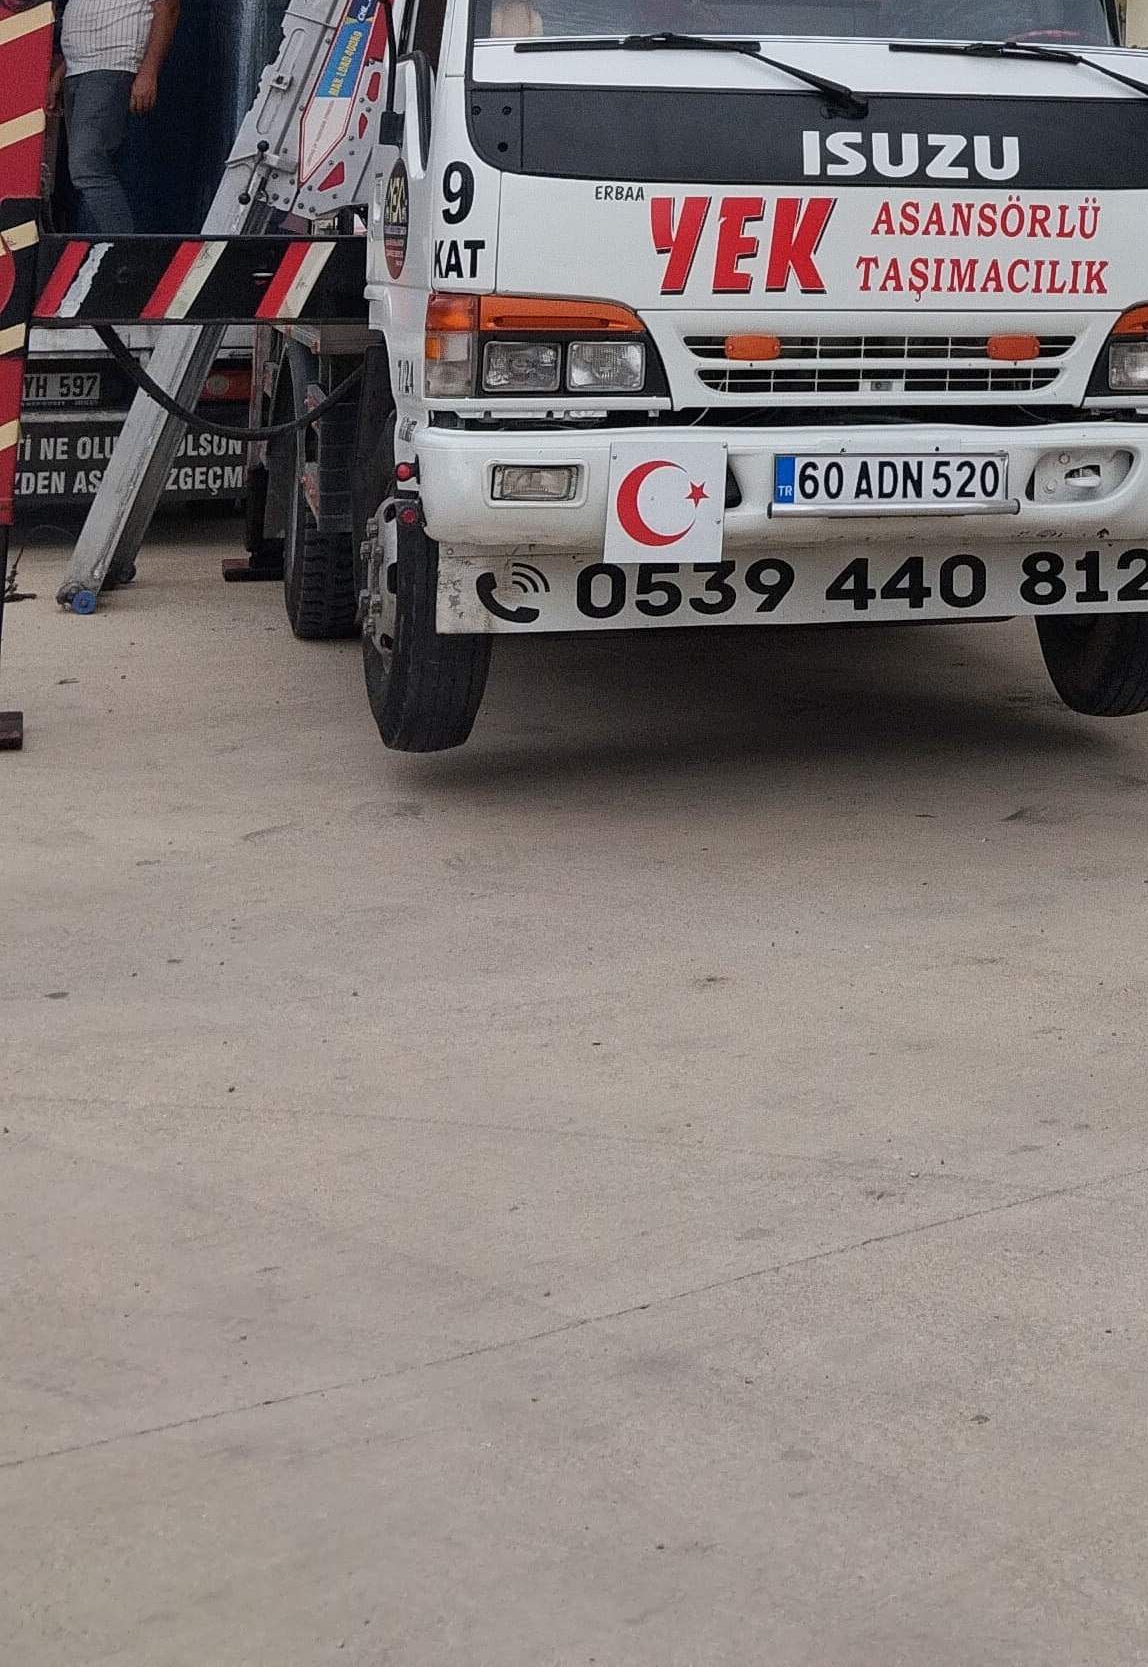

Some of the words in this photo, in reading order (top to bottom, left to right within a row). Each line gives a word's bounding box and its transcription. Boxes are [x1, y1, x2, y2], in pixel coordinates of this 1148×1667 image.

[802, 130, 1022, 182] ISUZU
[441, 160, 476, 225] 9
[594, 185, 646, 201] ERBAA
[871, 195, 1102, 240] ASANSÖRLÜ
[433, 239, 486, 279] KAT
[650, 196, 838, 296] YEK
[856, 256, 1110, 302] TAŞIMACILIK
[23, 376, 48, 399] YH
[60, 375, 98, 398] 597
[40, 437, 69, 460] NE
[72, 470, 102, 494] AS
[165, 465, 244, 496] ZGEÇM
[778, 484, 793, 497] TR
[799, 461, 844, 500] 60
[853, 460, 924, 500] ADN
[932, 460, 1000, 499] 520
[575, 557, 796, 618] 0539
[825, 554, 988, 612] 440
